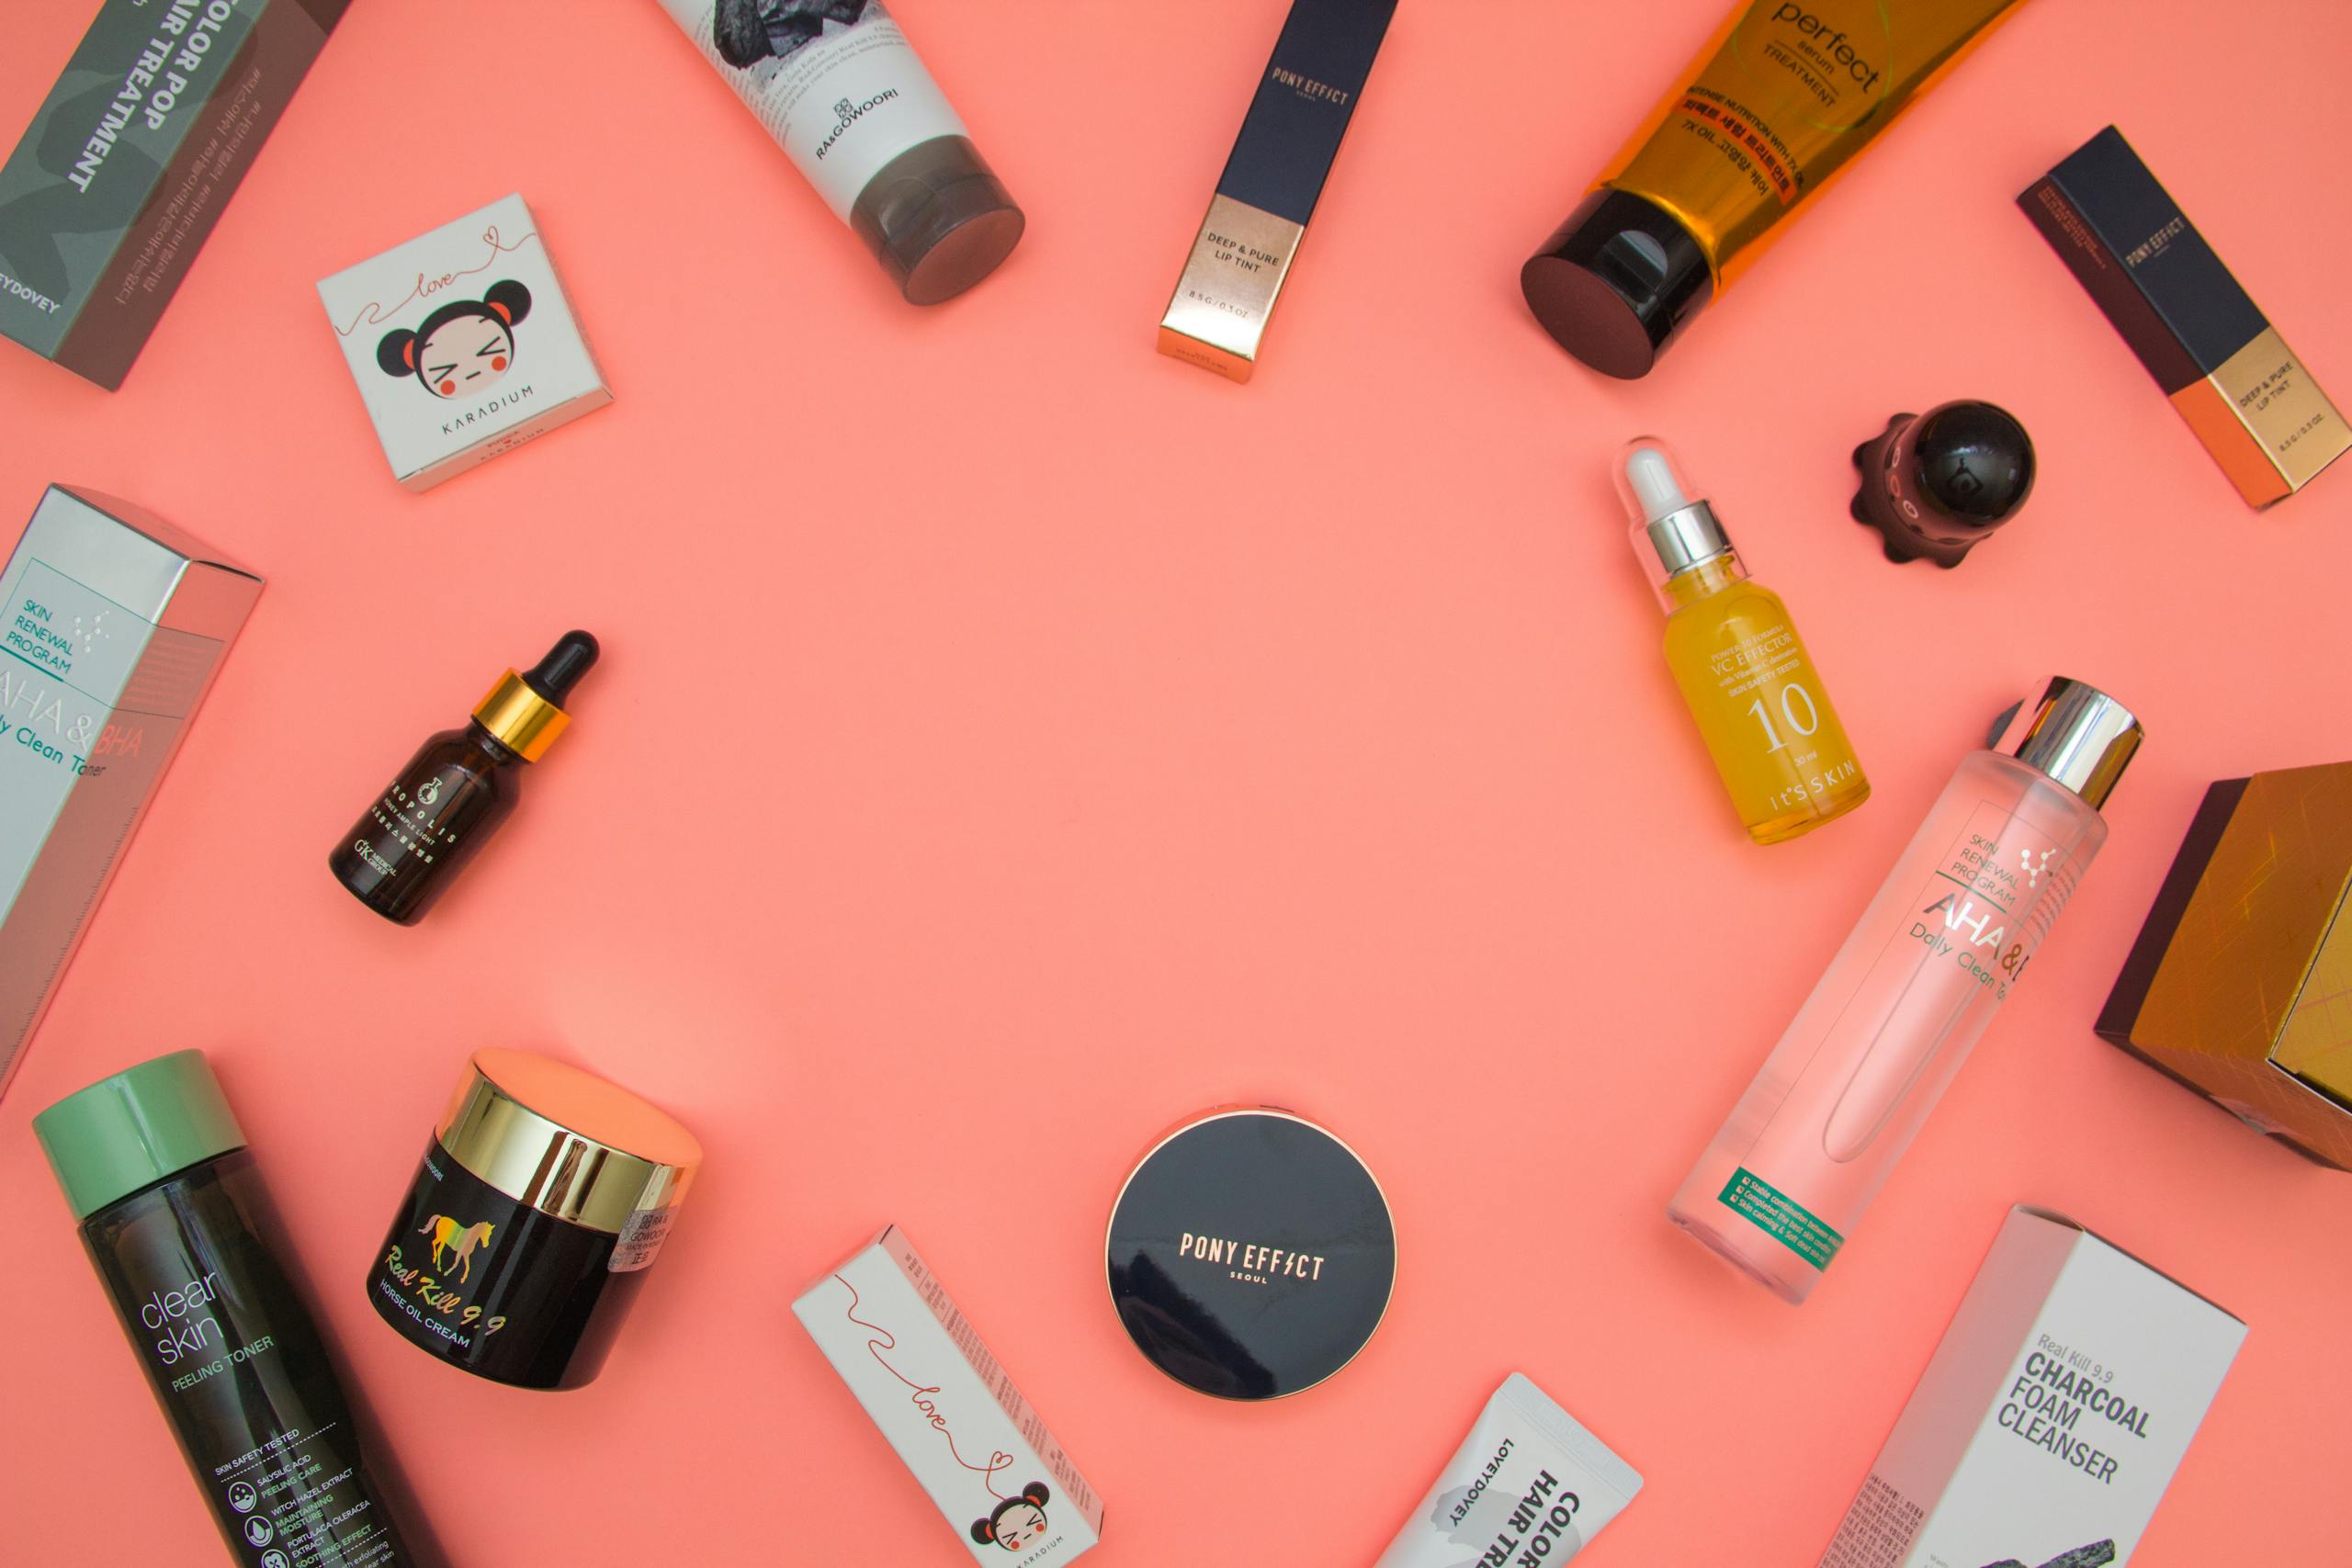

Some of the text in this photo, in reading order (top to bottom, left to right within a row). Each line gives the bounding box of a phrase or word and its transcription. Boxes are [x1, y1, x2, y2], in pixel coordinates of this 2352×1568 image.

[143, 0, 237, 130] OLOR POP
[1771, 3, 1879, 94] perfect
[1798, 41, 1834, 74] serum
[1272, 67, 1303, 87] PONY
[1764, 44, 1836, 107] TREATMENT
[69, 39, 174, 193] TREATMENT
[816, 88, 899, 160] RA&GOWOORI
[1718, 111, 1749, 141] 세럼
[1724, 99, 1771, 140] NUTRITION
[1698, 125, 1715, 143] OIL
[1749, 169, 1773, 197] 케어
[1208, 232, 1279, 265] DEEP & PURE
[1214, 249, 1261, 273] LIP TINT
[416, 273, 454, 297] love
[442, 386, 533, 434] KARADIUM
[24, 599, 52, 622] SKIN
[6, 631, 72, 673] PROGRAM
[15, 615, 73, 656] RENEWAL
[1711, 655, 1735, 676] VC
[1735, 629, 1794, 668] EFFECTOR
[66, 714, 93, 753] &
[91, 719, 143, 757] BHA
[1747, 682, 1818, 753] 10
[17, 728, 62, 763] Clean
[72, 754, 106, 778] Toner
[1811, 761, 1854, 793] SKIN
[393, 785, 456, 842] ROPOLIS
[416, 829, 435, 845] LIGHT
[1970, 833, 1999, 855] SKIN
[1951, 862, 2016, 905] PROGRAM
[1960, 848, 2018, 889] RENEWAL
[1909, 922, 1952, 956] Daily
[1958, 952, 1996, 988] Clean
[1923, 892, 2004, 960] AHA
[2001, 943, 2024, 976] &
[1178, 1232, 1238, 1265] PONY
[142, 1269, 217, 1328] clear
[385, 1246, 505, 1337] Real Kill 9.9
[1228, 1270, 1268, 1285] SEOUL
[380, 1279, 469, 1348] HORSE OIL CREAM
[158, 1313, 223, 1364] skin
[2038, 1333, 2113, 1383] Real Kill 9.9
[172, 1337, 274, 1392] PEELING TONER
[912, 1387, 946, 1426] love
[2010, 1376, 2081, 1430] FOAM
[2026, 1352, 2149, 1438] CHARCOAL
[215, 1429, 299, 1475] SKIN SAFETY TESTED
[1998, 1404, 2118, 1484] CLEANSER
[257, 1454, 311, 1486] SALYSILIC ACID
[261, 1462, 322, 1498] PEELING CARE
[271, 1468, 352, 1516] WITCH HAZEL EXTRACT
[1450, 1438, 1514, 1527] LOVEYDOVEY
[276, 1495, 334, 1528] MAINTAINING
[279, 1508, 325, 1536] MOISTURE
[287, 1499, 370, 1549] PORTULACA OLERACEA
[1508, 1470, 1558, 1533] HAIR
[292, 1537, 323, 1558] EXTRACT
[296, 1524, 370, 1568] SOOTHING EFFECT
[1517, 1492, 1579, 1568] COLOR
